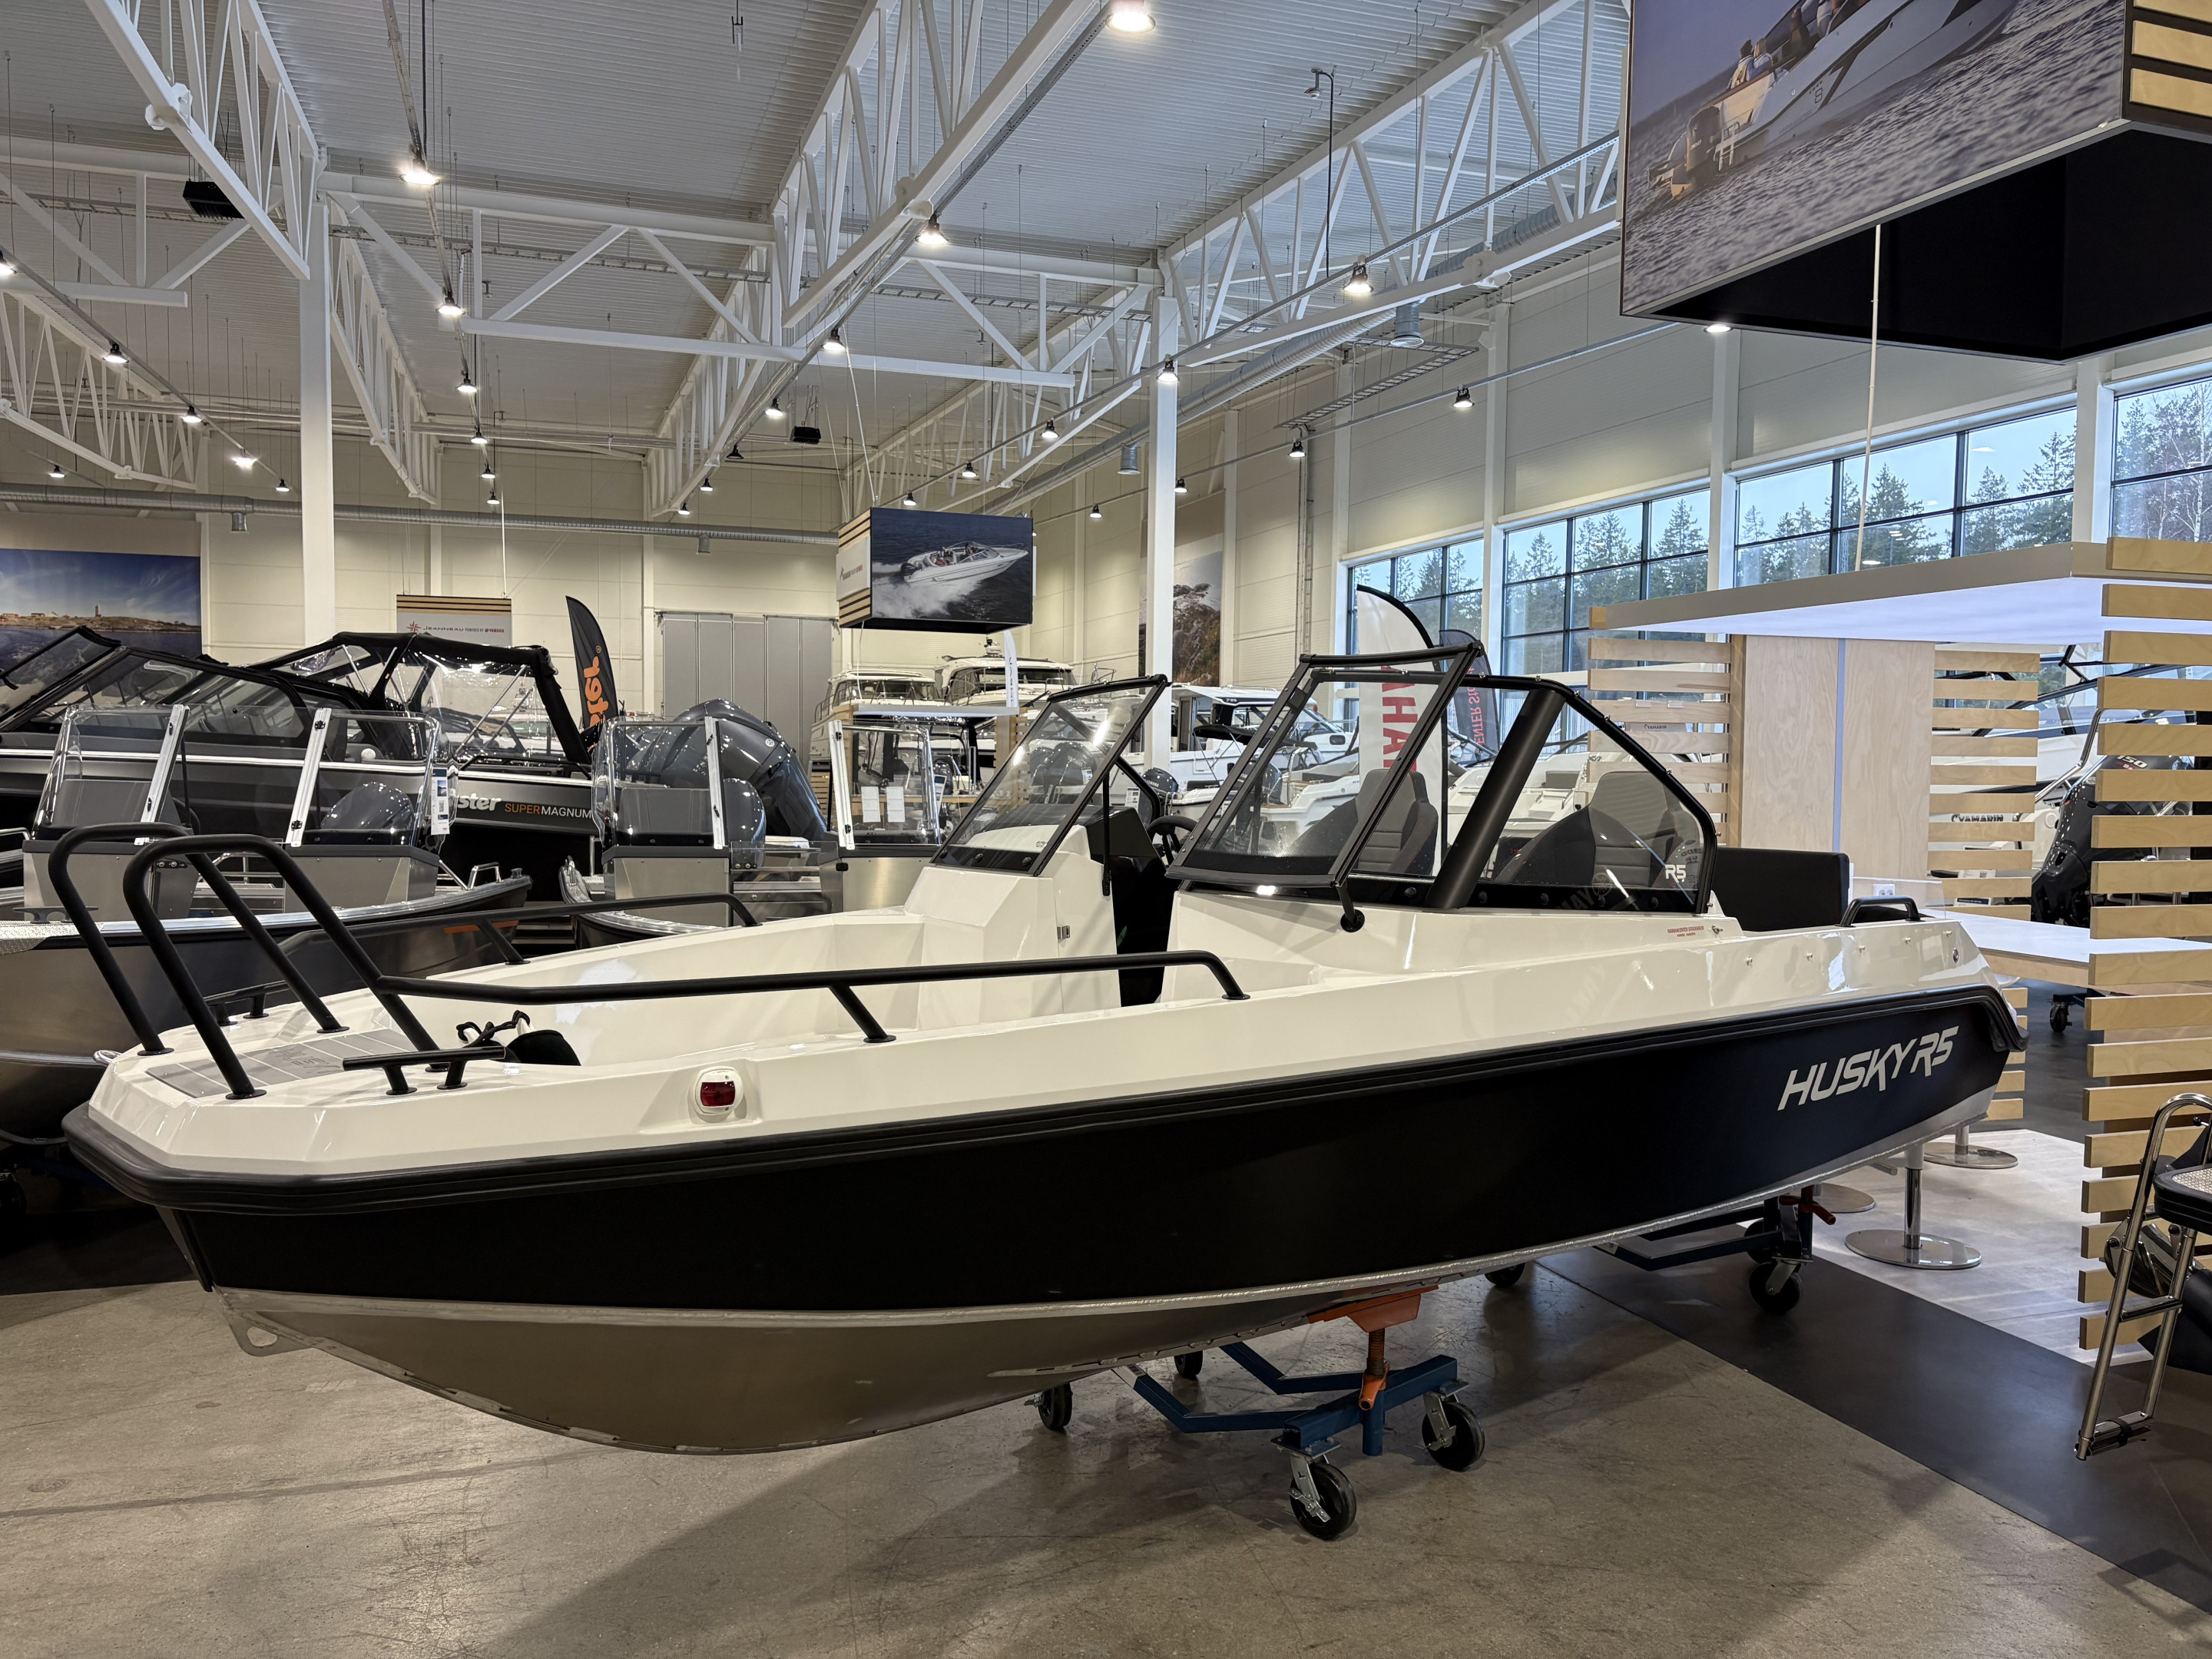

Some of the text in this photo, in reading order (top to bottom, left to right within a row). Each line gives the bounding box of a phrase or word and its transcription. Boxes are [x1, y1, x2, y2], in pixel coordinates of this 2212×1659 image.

[1664, 864, 1687, 883] R5
[1777, 1025, 1959, 1111] HUSKY R5
